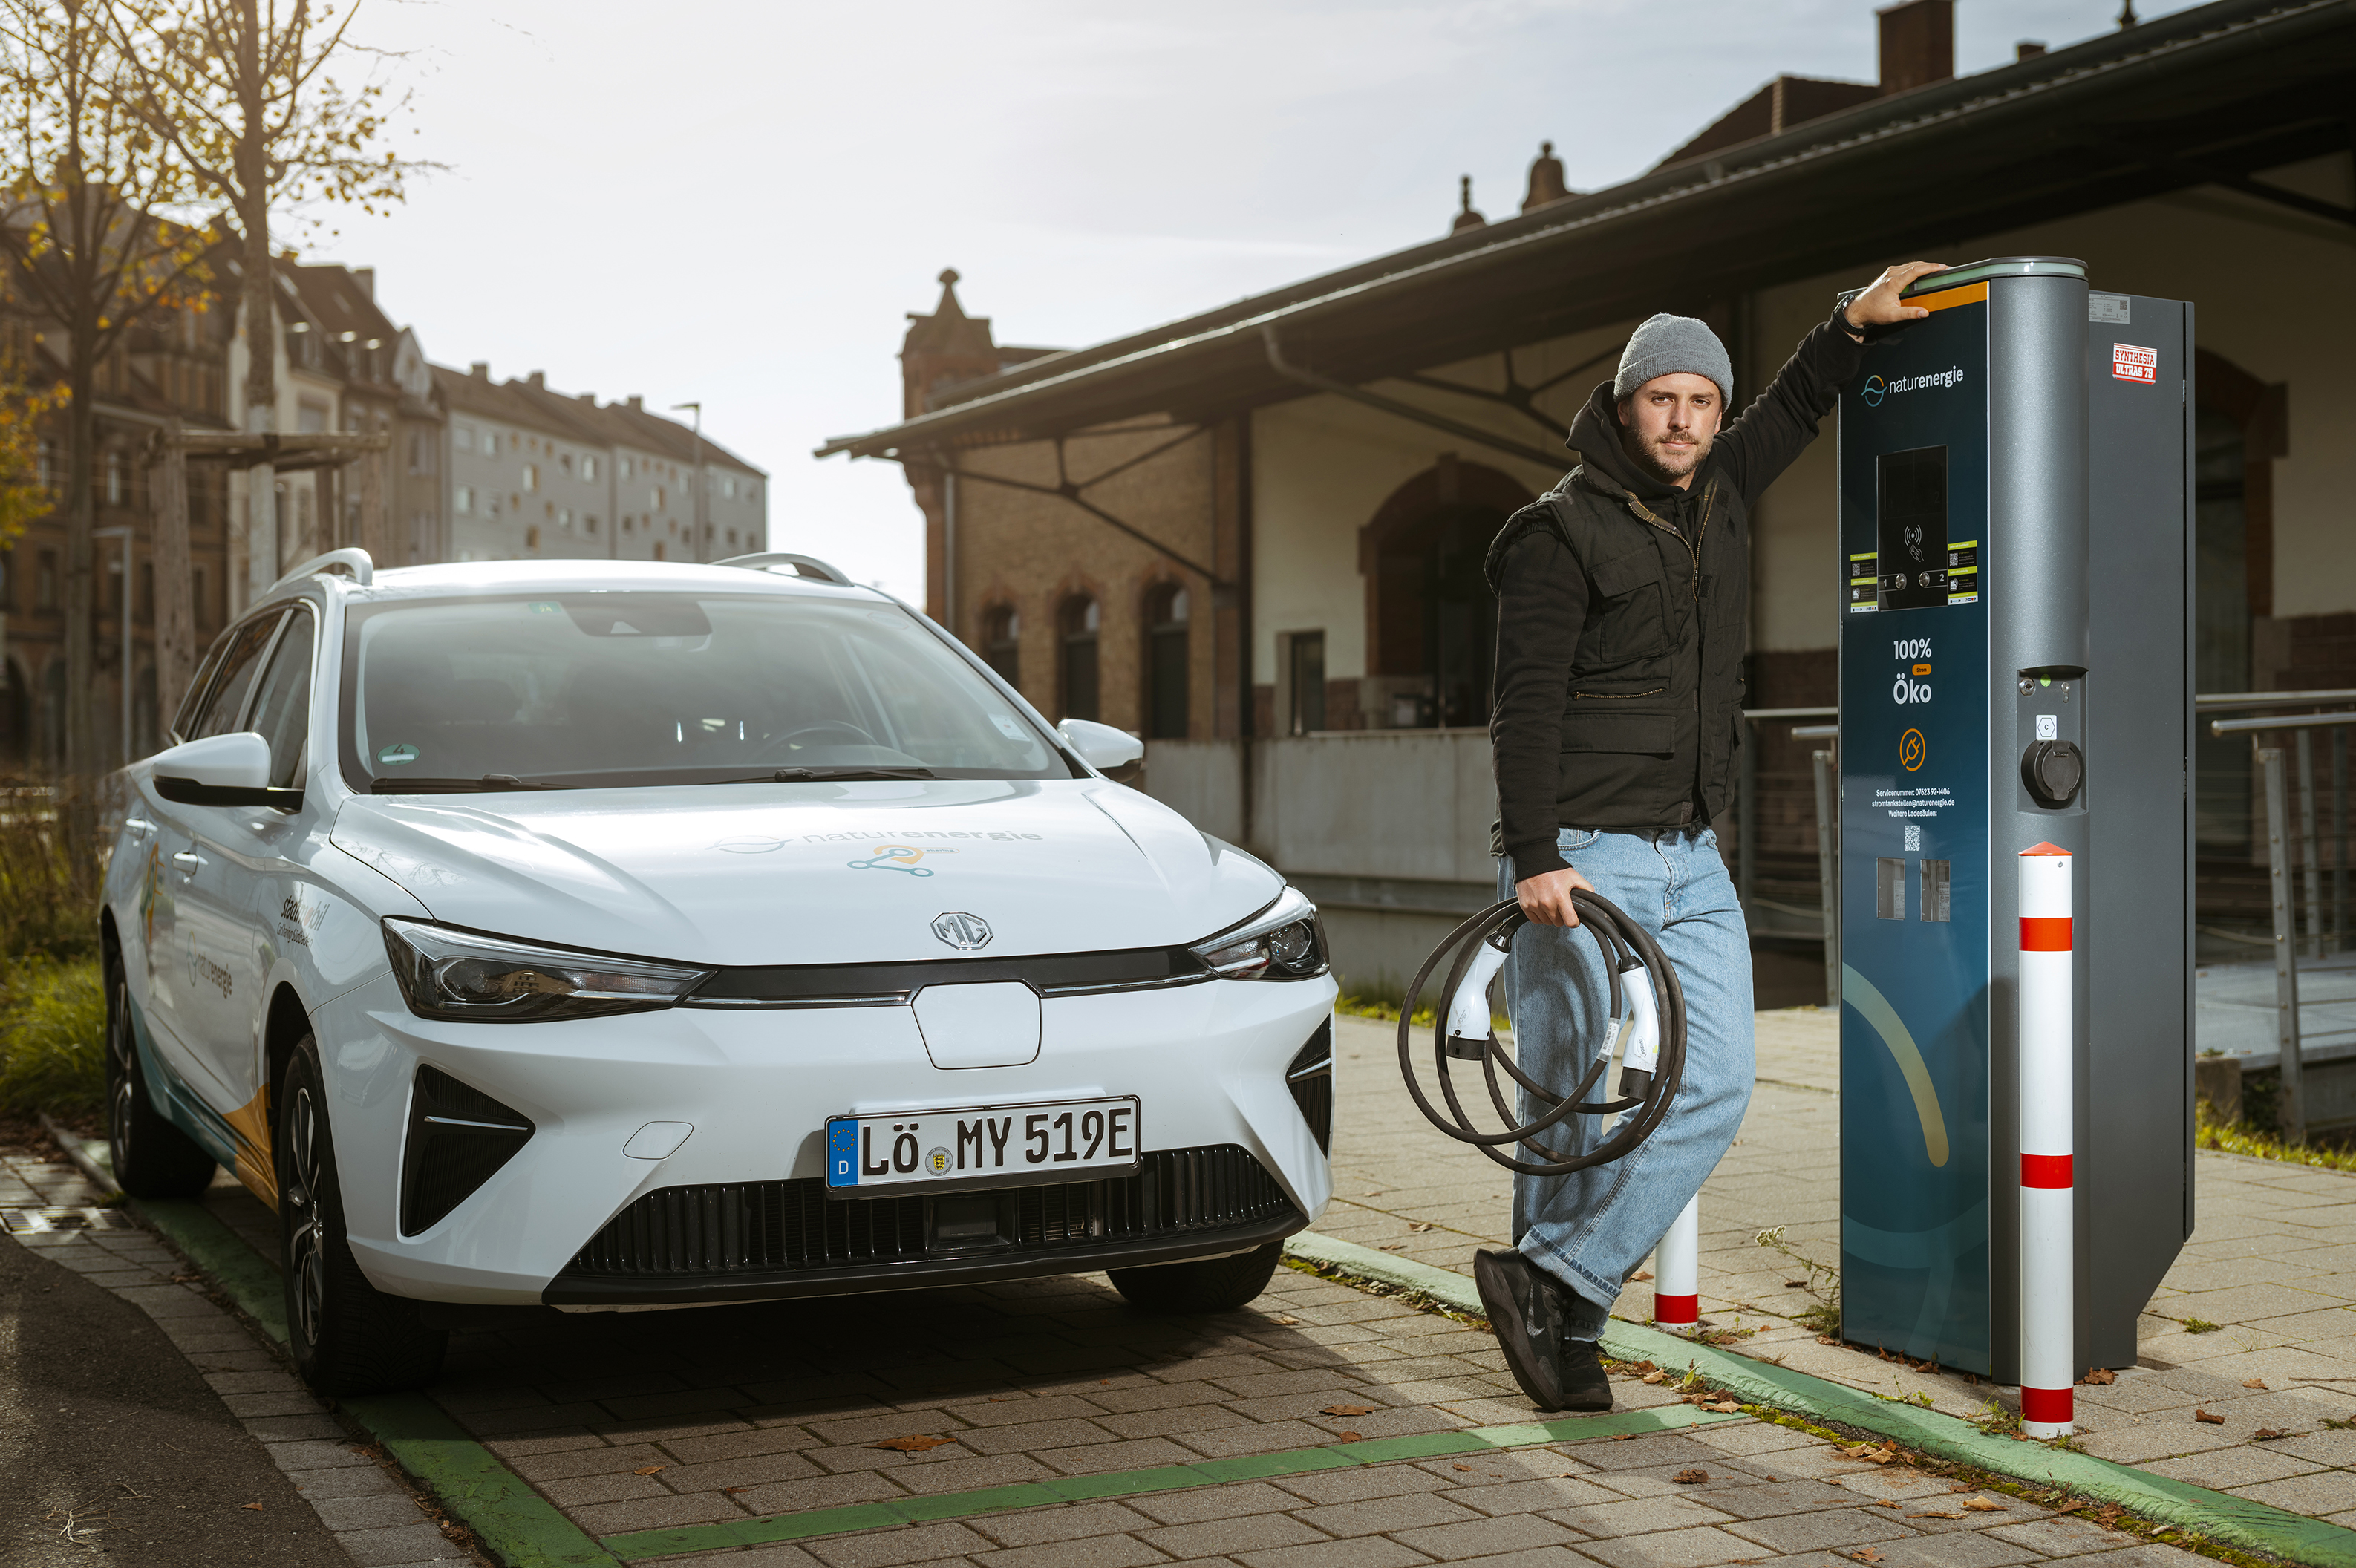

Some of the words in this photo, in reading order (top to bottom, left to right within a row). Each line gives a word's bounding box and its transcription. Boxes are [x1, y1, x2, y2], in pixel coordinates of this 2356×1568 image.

[2115, 350, 2155, 365] SYNTHESIA
[2115, 363, 2143, 377] ULTRAS
[2144, 367, 2153, 379] 79
[1889, 365, 1964, 393] naturenergie
[1883, 578, 1887, 587] 1
[1939, 573, 1945, 582] 2
[1893, 638, 1932, 660] 100%
[1893, 673, 1932, 705] Öko
[393, 744, 405, 754] 4
[1915, 788, 1931, 796] 07623
[1871, 798, 1955, 808] stromtankstellen@naturenergie.de
[802, 830, 1044, 843] naturenergie
[936, 915, 987, 945] MG
[198, 951, 232, 1000] naturenergie
[862, 1123, 919, 1176] LÖ
[957, 1116, 1012, 1169] MY
[1025, 1108, 1133, 1163] 519E
[838, 1160, 849, 1175] D
